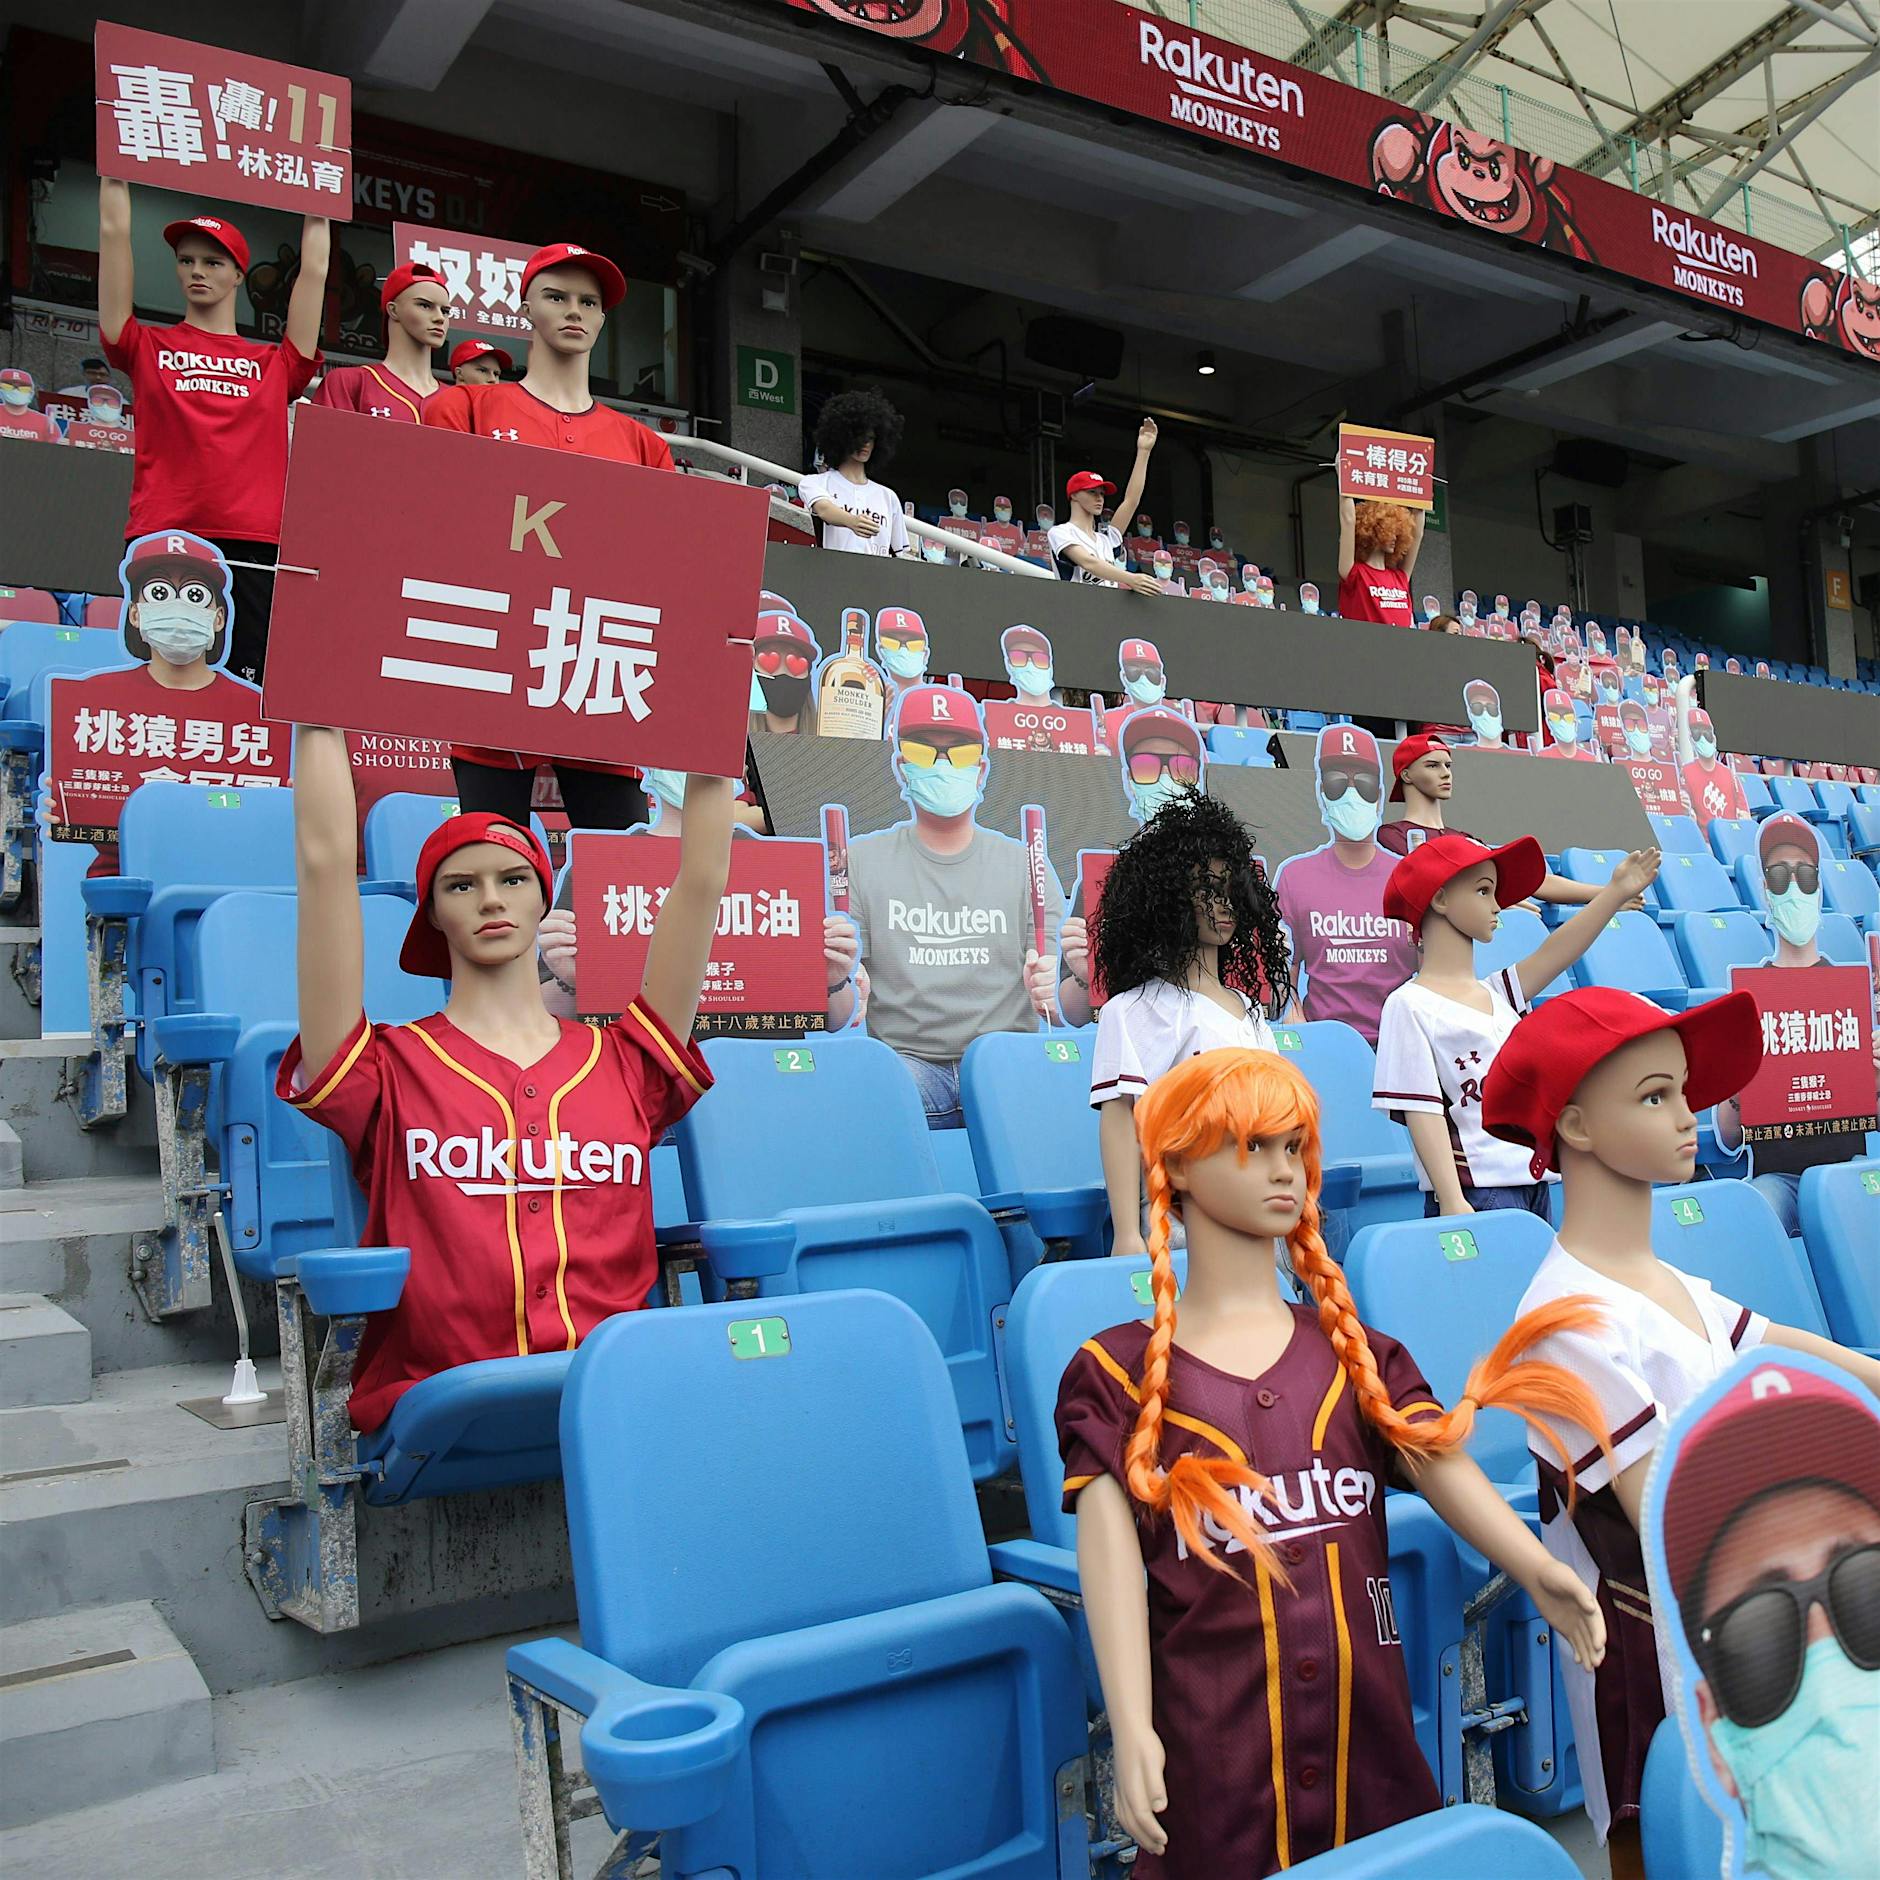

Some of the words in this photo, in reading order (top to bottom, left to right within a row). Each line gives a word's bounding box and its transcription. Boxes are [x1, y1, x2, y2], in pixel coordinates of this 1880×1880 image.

[1139, 20, 1305, 118] Rakuten
[110, 64, 232, 166] 轟!
[217, 77, 278, 133] 轟!
[288, 83, 337, 153] 11
[1170, 94, 1281, 152] MONKEYS
[236, 144, 344, 194] 林泓育
[1651, 207, 1758, 279] Rakuten
[1673, 265, 1745, 308] MONKEYS
[158, 349, 262, 381] Rakuten
[755, 358, 779, 389] D
[175, 378, 250, 398] MONKEYS
[760, 391, 785, 404] West
[89, 429, 108, 439] GO
[109, 431, 128, 441] GO
[1346, 444, 1429, 476] 一棒得分
[1351, 469, 1390, 489] 朱育賢
[509, 494, 568, 559] K
[166, 536, 187, 554] R
[777, 616, 792, 635] R
[894, 612, 909, 628] R
[64, 631, 71, 641] 1
[380, 577, 662, 724] 三振
[1135, 643, 1146, 658] R
[833, 696, 873, 709] SHOULDER
[837, 689, 870, 701] MONKEY
[931, 694, 953, 721] R
[1014, 712, 1039, 729] GO
[1042, 715, 1067, 731] GO
[73, 707, 274, 767] 桃猿男兒
[361, 735, 444, 753] MONKEY
[1341, 731, 1356, 753] R
[352, 752, 452, 771] SHOULDER
[71, 768, 124, 782] 三隻猴子
[1631, 766, 1647, 780] GO
[1647, 767, 1663, 781] GO
[219, 794, 228, 807] 1
[451, 804, 461, 816] 2
[1033, 828, 1045, 907] Rakuten
[602, 884, 801, 938] 桃加油
[888, 899, 1008, 936] Rakuten
[1309, 909, 1401, 938] Rakuten
[908, 946, 990, 966] MONKEYS
[1326, 947, 1388, 963] MONKEYS
[705, 961, 736, 977] 猴子
[707, 995, 746, 1003] SHOULDER
[695, 1013, 826, 1031] 滿十八歲禁止飲酒
[1283, 1034, 1293, 1047] 4
[787, 1052, 802, 1070] 2
[1056, 1043, 1069, 1061] 3
[1795, 1116, 1877, 1137] 未滿十八歲禁止飲酒
[405, 1126, 644, 1186] Rakuten
[1871, 1172, 1880, 1192] 5
[1683, 1201, 1694, 1221] 4
[1450, 1233, 1466, 1257] 3
[751, 1323, 767, 1354] 1
